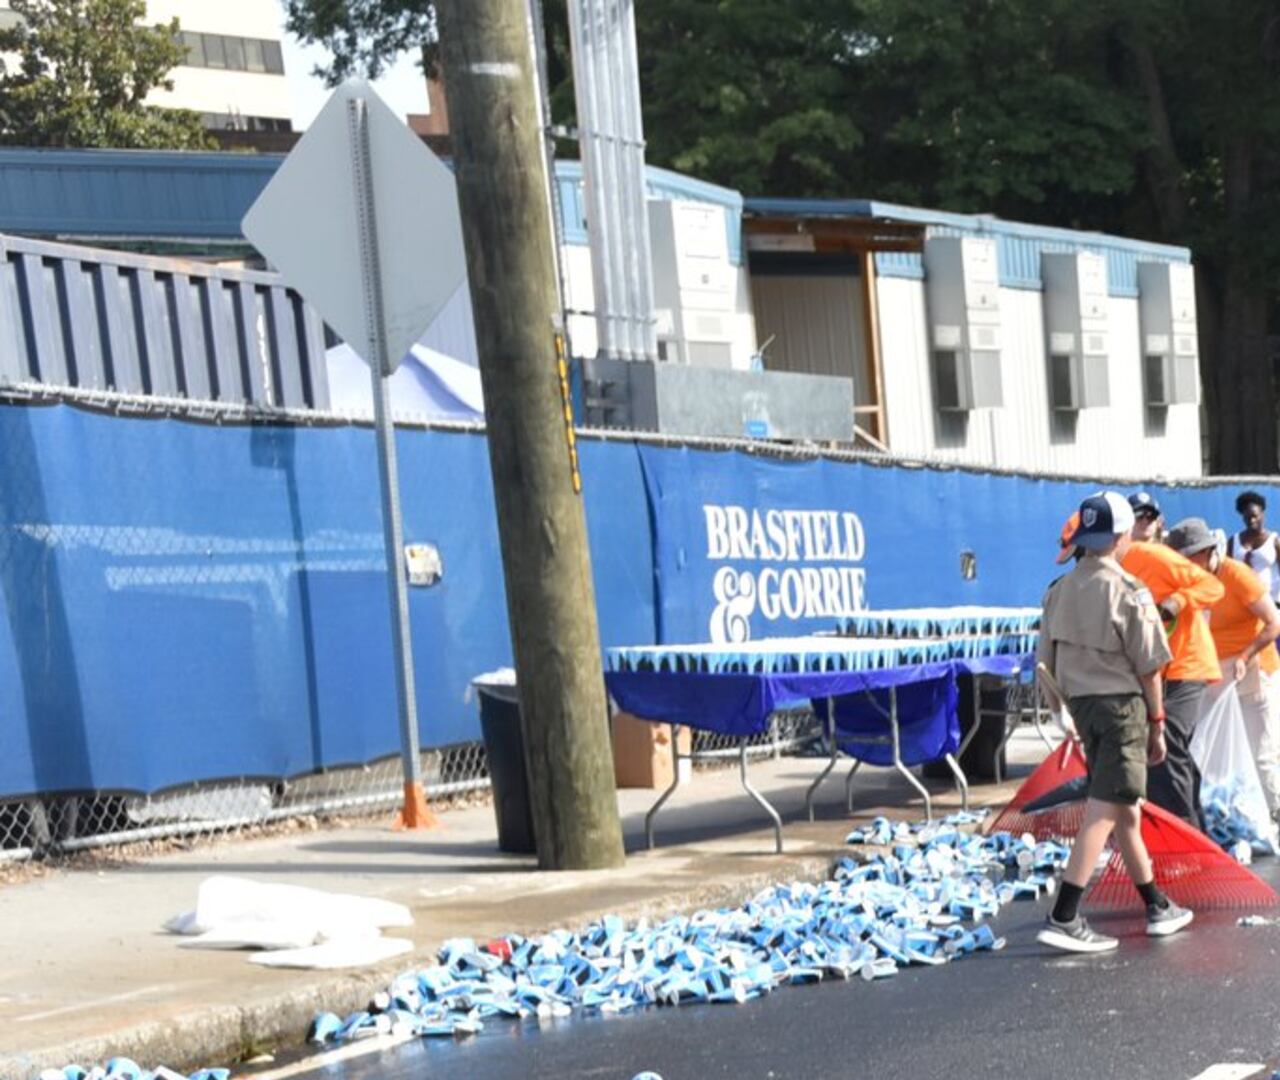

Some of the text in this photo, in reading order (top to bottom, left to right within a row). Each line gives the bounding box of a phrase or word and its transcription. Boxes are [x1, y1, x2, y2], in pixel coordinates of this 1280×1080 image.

[703, 505, 865, 561] BRASFIELD
[709, 566, 869, 644] & GORRIE
